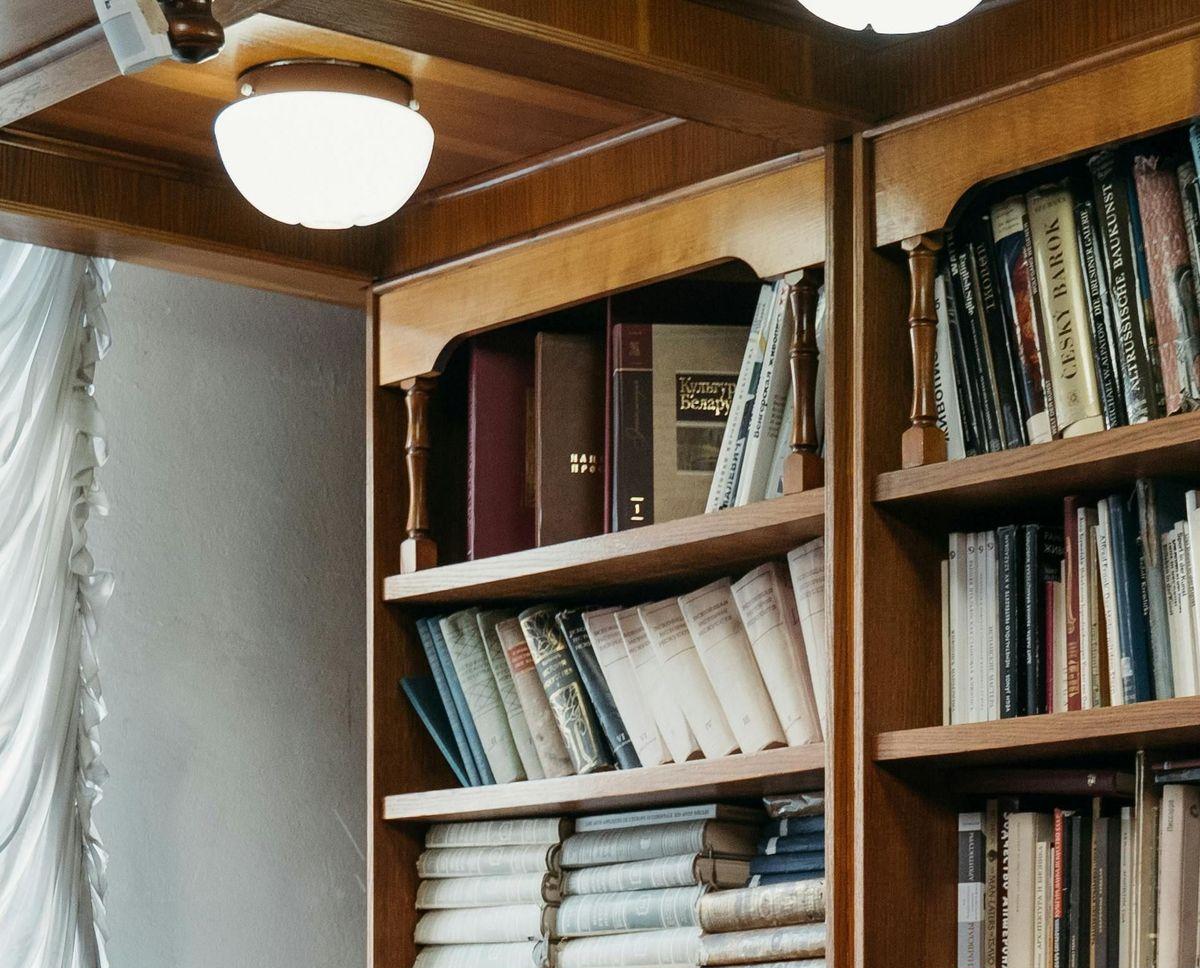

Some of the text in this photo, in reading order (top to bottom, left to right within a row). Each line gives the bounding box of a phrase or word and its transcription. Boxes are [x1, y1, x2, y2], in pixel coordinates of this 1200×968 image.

[1044, 216, 1068, 298] BAROK
[1100, 182, 1143, 391] ALTRUSSISCHE BAUKUNST
[1092, 300, 1102, 316] DIE
